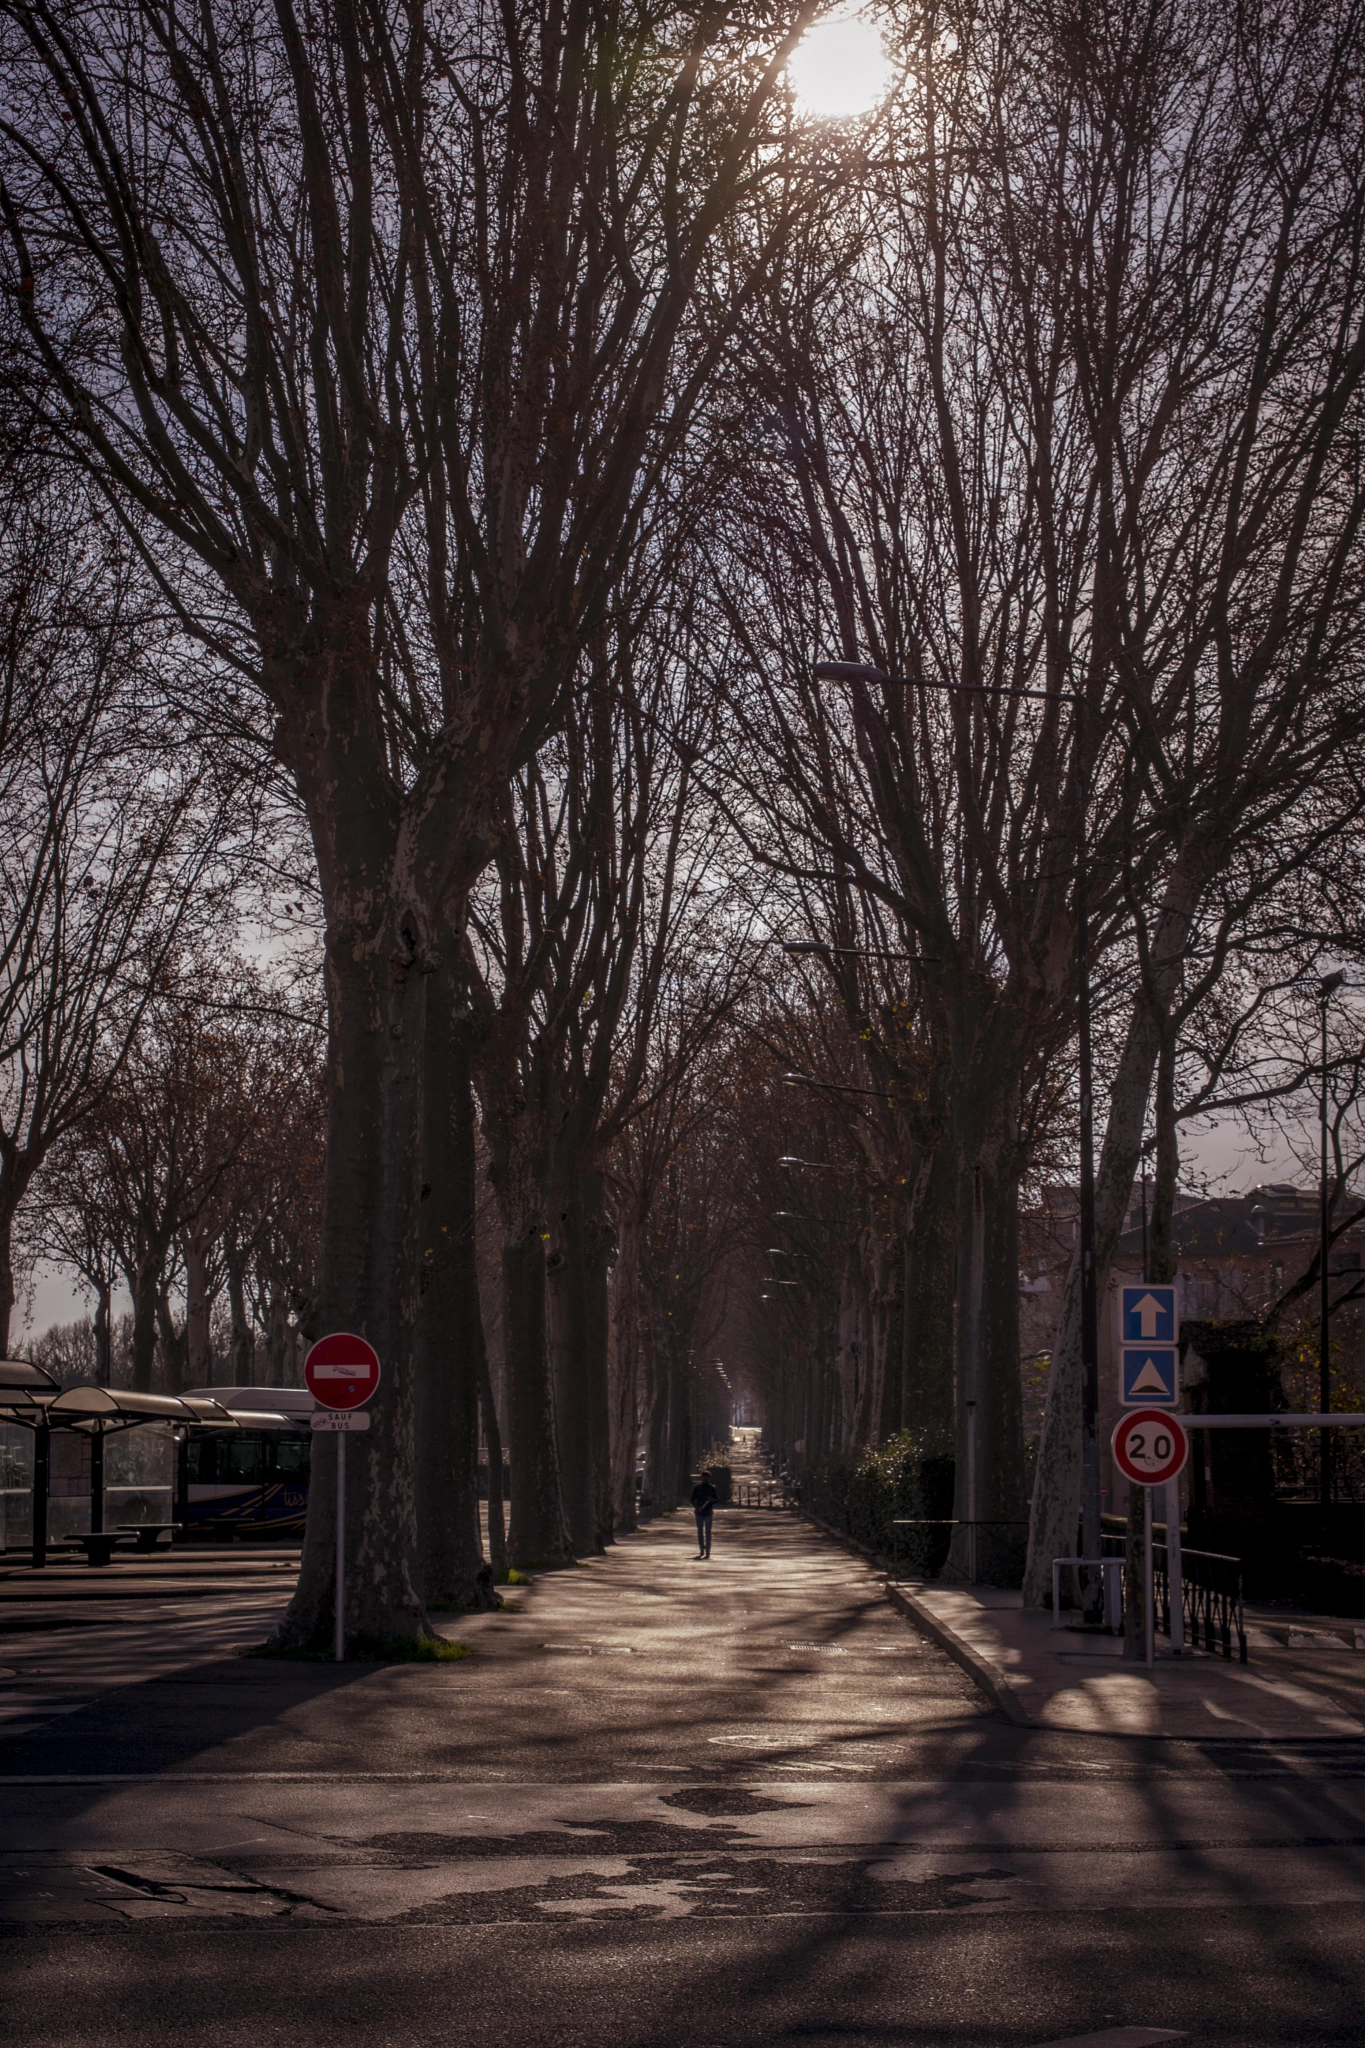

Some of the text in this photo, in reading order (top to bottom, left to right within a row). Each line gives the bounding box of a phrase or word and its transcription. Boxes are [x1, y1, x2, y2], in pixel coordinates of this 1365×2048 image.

[328, 1413, 353, 1421] SAUF
[331, 1422, 349, 1430] BUS
[1130, 1434, 1171, 1460] 20
